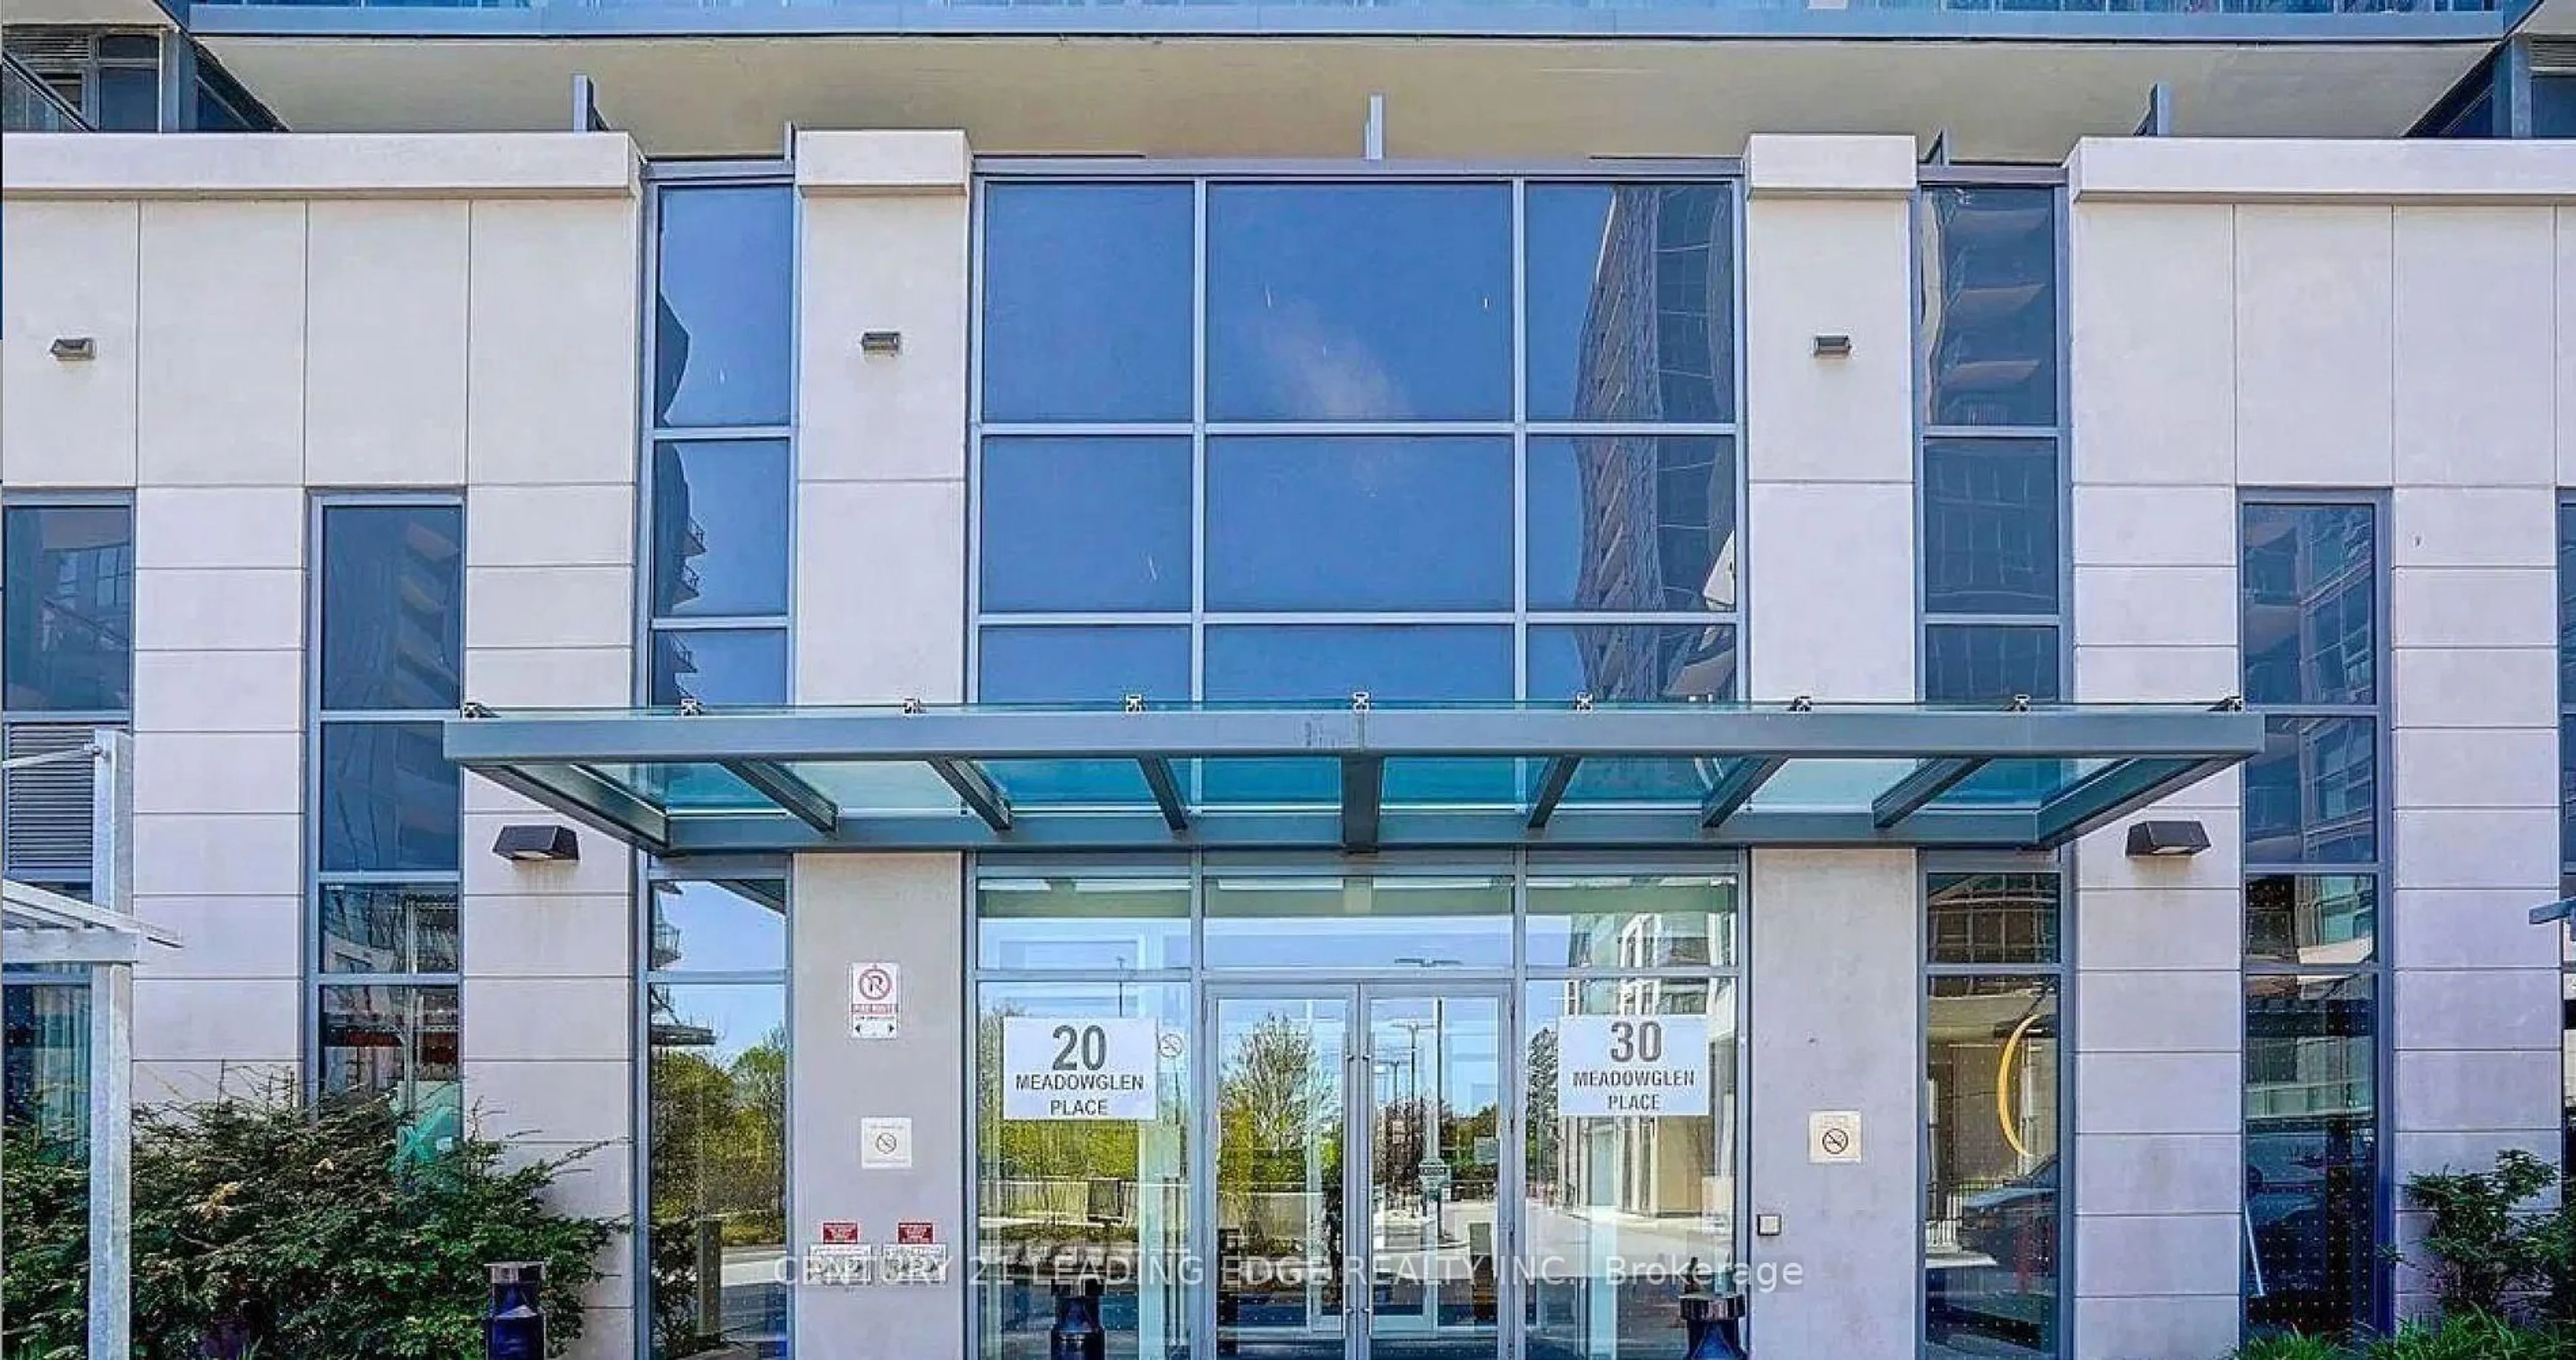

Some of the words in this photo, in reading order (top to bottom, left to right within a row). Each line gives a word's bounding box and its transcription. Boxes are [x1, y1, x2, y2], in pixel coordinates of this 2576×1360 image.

[1052, 1025, 1107, 1071] 20
[1611, 1020, 1662, 1063] 30
[1016, 1074, 1144, 1090] MEADOWGLEN
[1572, 1070, 1695, 1086] MEADOWGLEN
[1051, 1099, 1109, 1116] PLACE
[1608, 1094, 1660, 1110] PLACE
